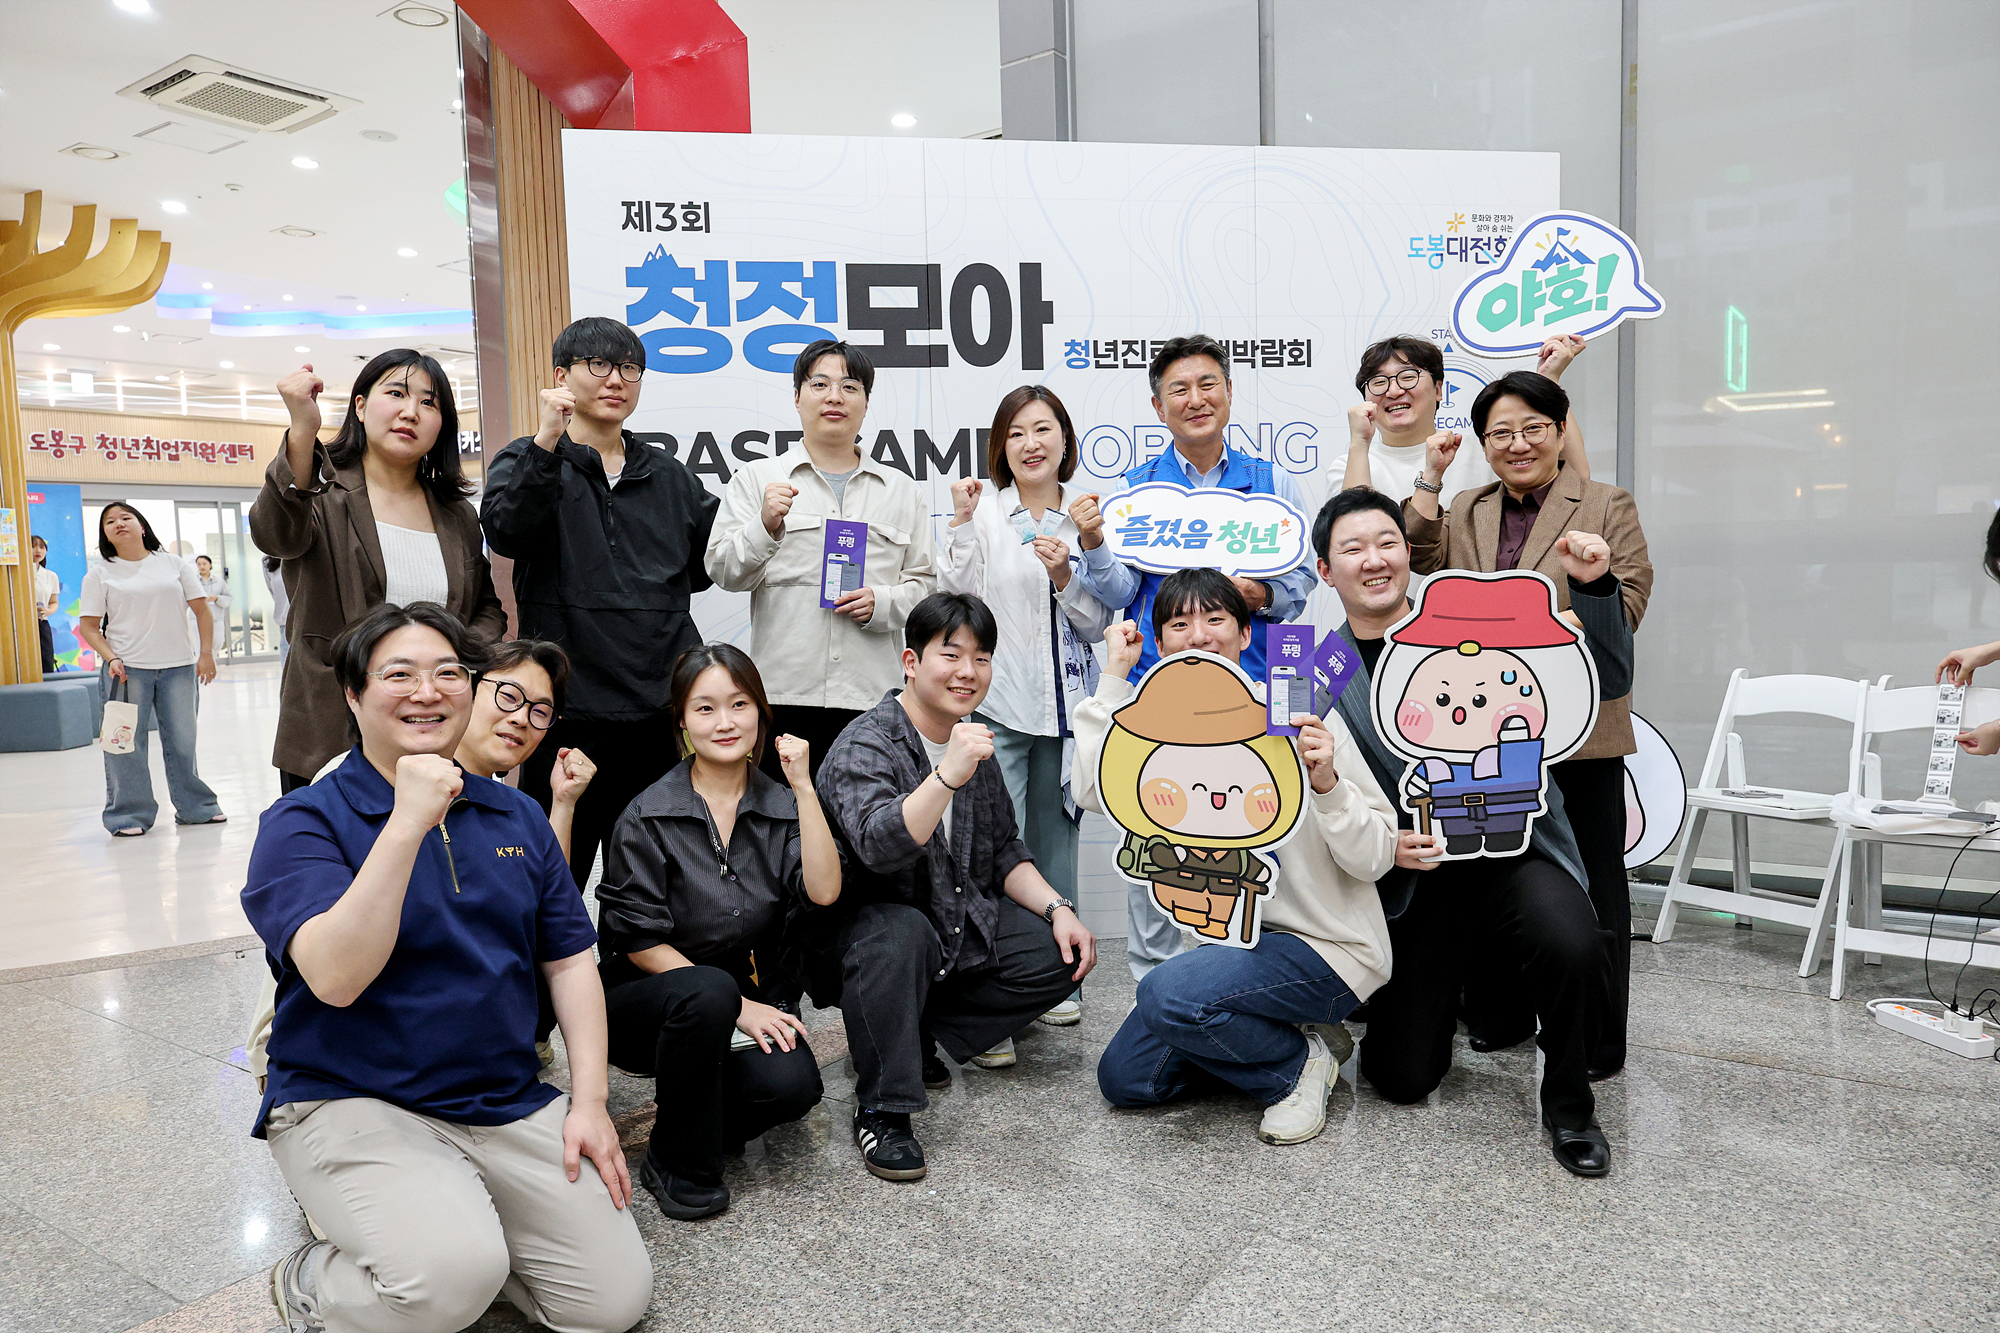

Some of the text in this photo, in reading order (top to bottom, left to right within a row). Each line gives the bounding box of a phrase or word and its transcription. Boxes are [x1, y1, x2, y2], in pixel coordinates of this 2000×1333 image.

[621, 200, 711, 234] 제3회
[1471, 213, 1514, 223] 문화와 경제가
[1476, 224, 1514, 233] 살아 숨 쉬는
[625, 243, 1054, 374] 청정모아
[1476, 253, 1620, 333] 야호!
[1431, 329, 1453, 340] STA
[29, 429, 255, 464] 도봉구 청년취업지원센터
[1115, 514, 1281, 555] 즐겼음 청년
[1281, 644, 1301, 658] 푸링
